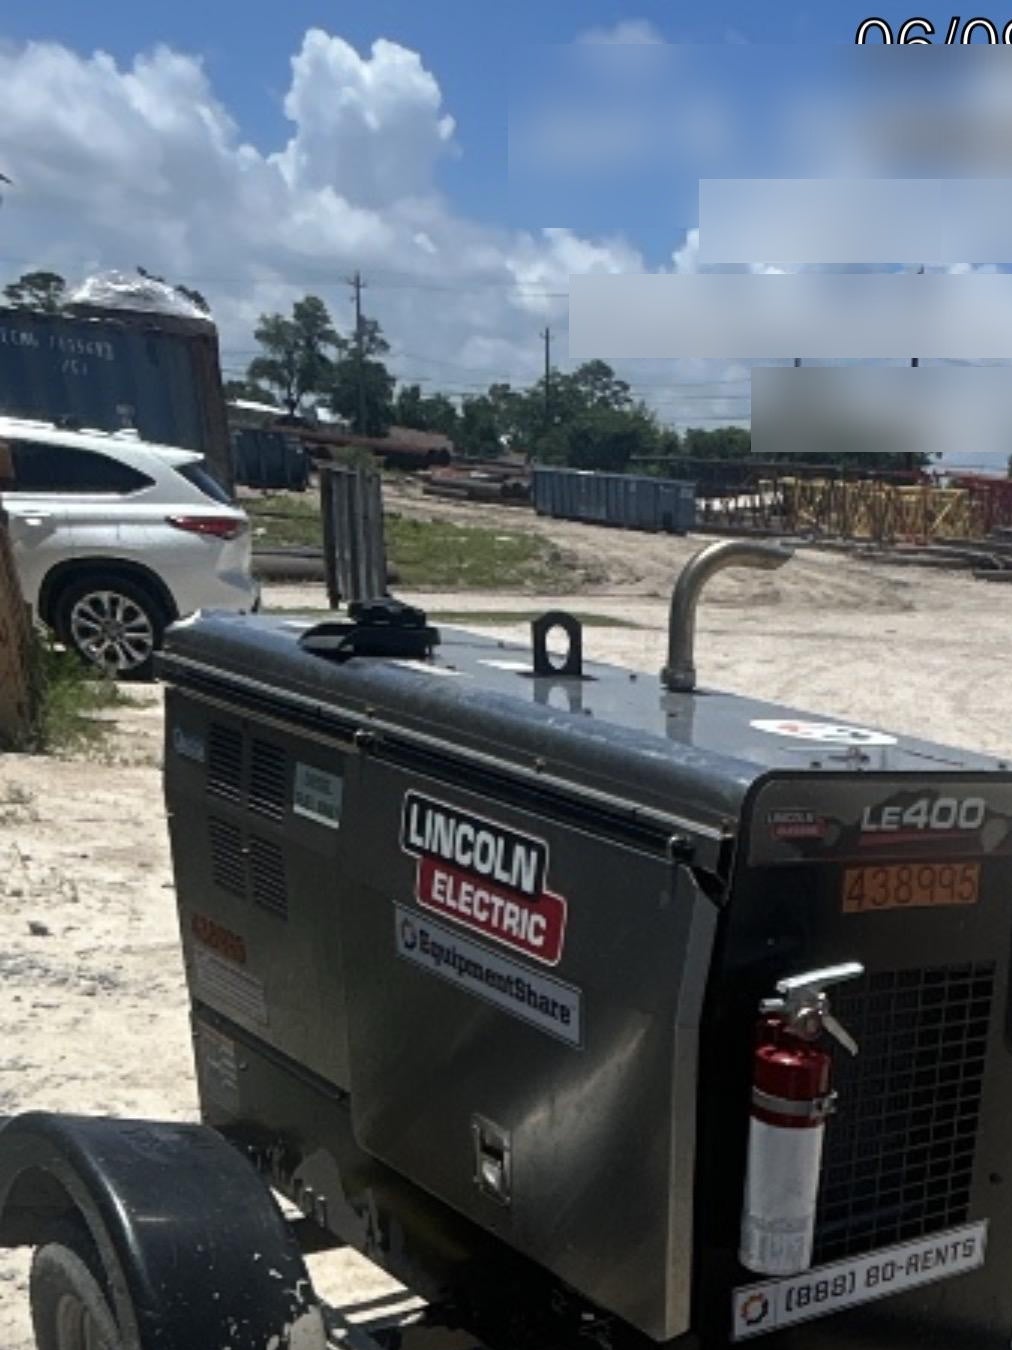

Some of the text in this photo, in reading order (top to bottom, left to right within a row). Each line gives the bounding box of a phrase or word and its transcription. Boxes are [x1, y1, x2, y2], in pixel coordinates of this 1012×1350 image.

[861, 797, 987, 832] LE400
[409, 802, 538, 893] LINCOLN
[430, 869, 547, 946] ELECTRIC
[847, 862, 978, 908] 438995
[419, 928, 572, 1025] EquipmentShare
[785, 1270, 857, 1313] (888)
